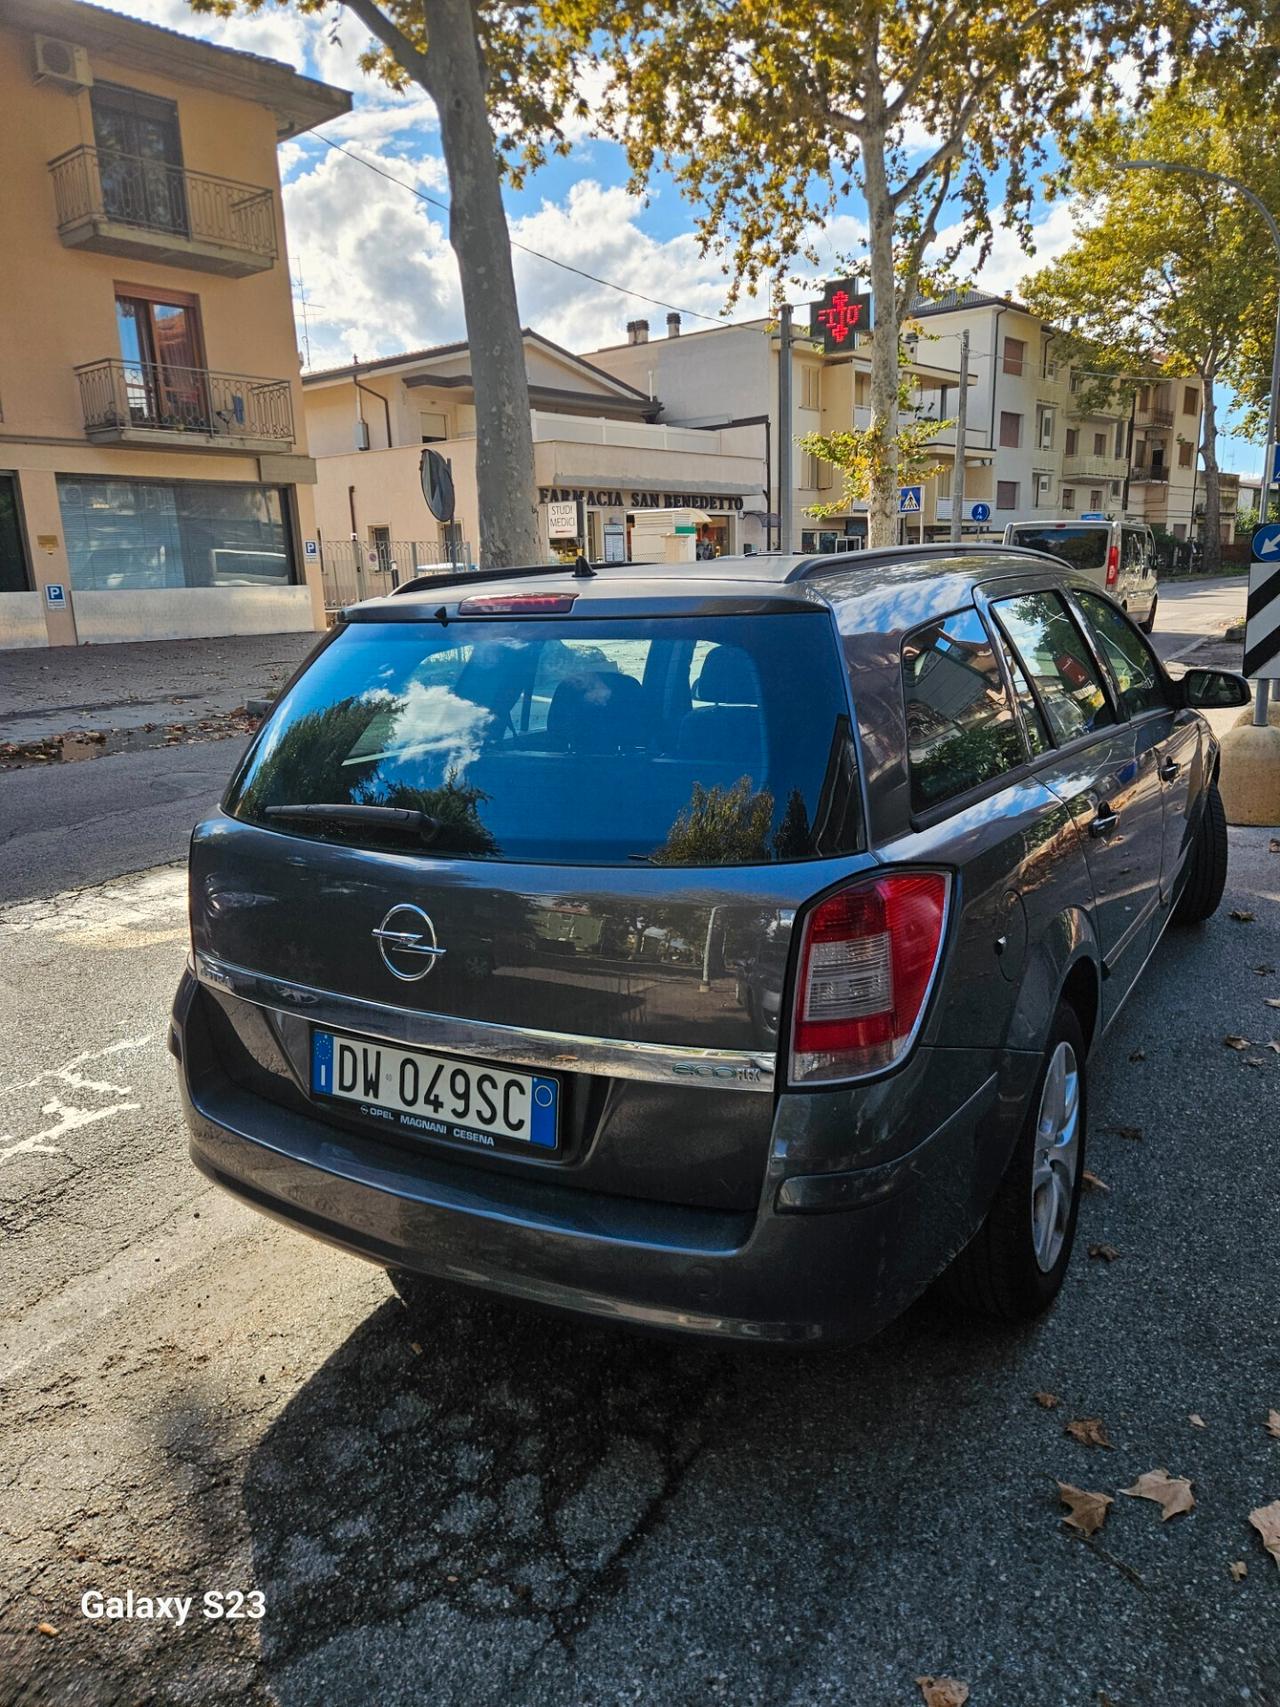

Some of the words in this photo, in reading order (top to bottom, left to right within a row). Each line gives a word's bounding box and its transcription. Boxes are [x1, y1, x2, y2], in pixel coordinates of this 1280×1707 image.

[539, 488, 624, 507] FARMACIA
[631, 492, 659, 508] SAN
[664, 494, 744, 511] BENEDETTO
[551, 505, 573, 516] STUDI
[550, 517, 575, 528] MEDICI
[307, 542, 315, 553] P
[50, 587, 60, 599] P
[338, 1043, 381, 1100] DW
[399, 1057, 526, 1132] 049SC
[369, 1107, 394, 1121] OPEL
[400, 1114, 447, 1134] MAGNANI
[453, 1128, 495, 1146] CESENA
